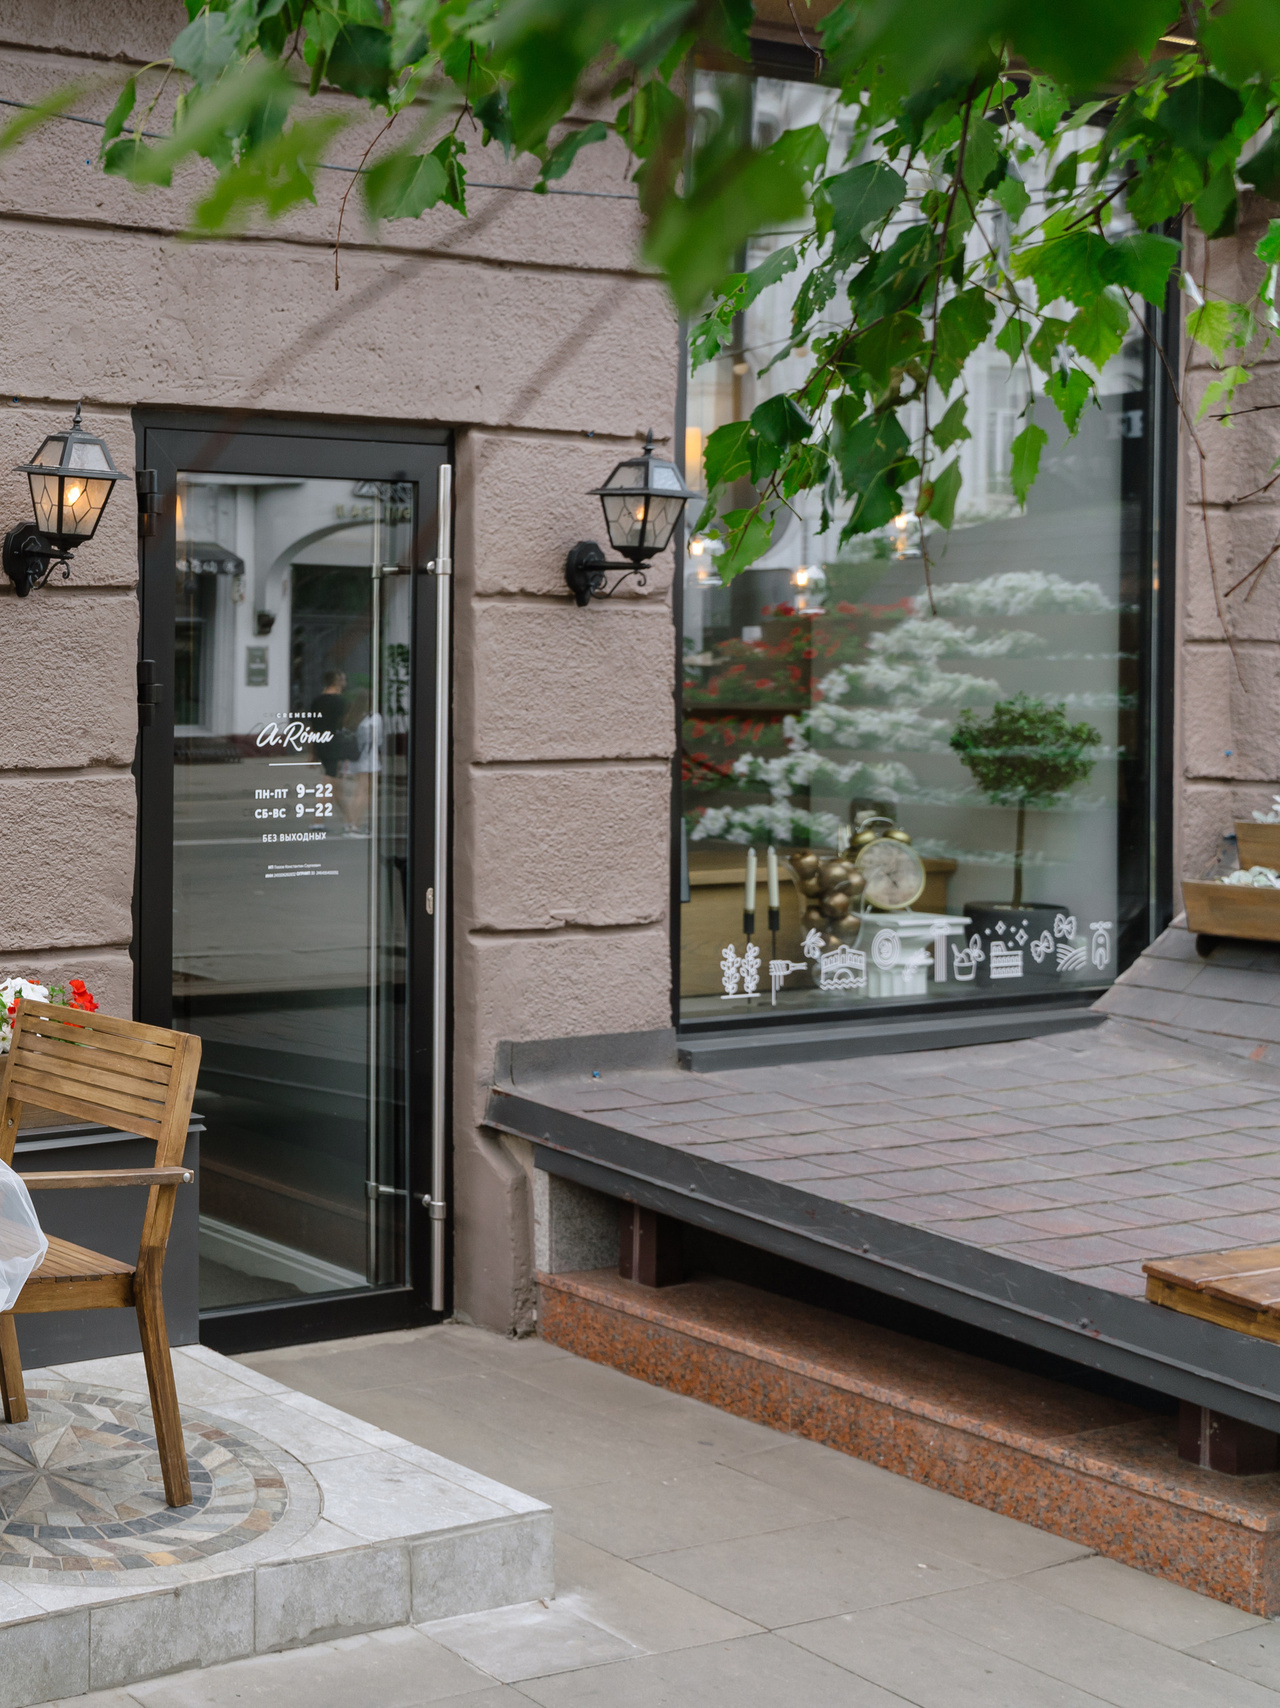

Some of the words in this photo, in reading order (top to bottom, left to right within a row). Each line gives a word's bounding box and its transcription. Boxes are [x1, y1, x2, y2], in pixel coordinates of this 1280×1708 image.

[255, 788, 288, 800] ПН-ПТ
[254, 808, 287, 819] СБ-ВС
[262, 834, 277, 843] БЕЗ
[279, 831, 327, 843] ВЫХОДНЫХ
